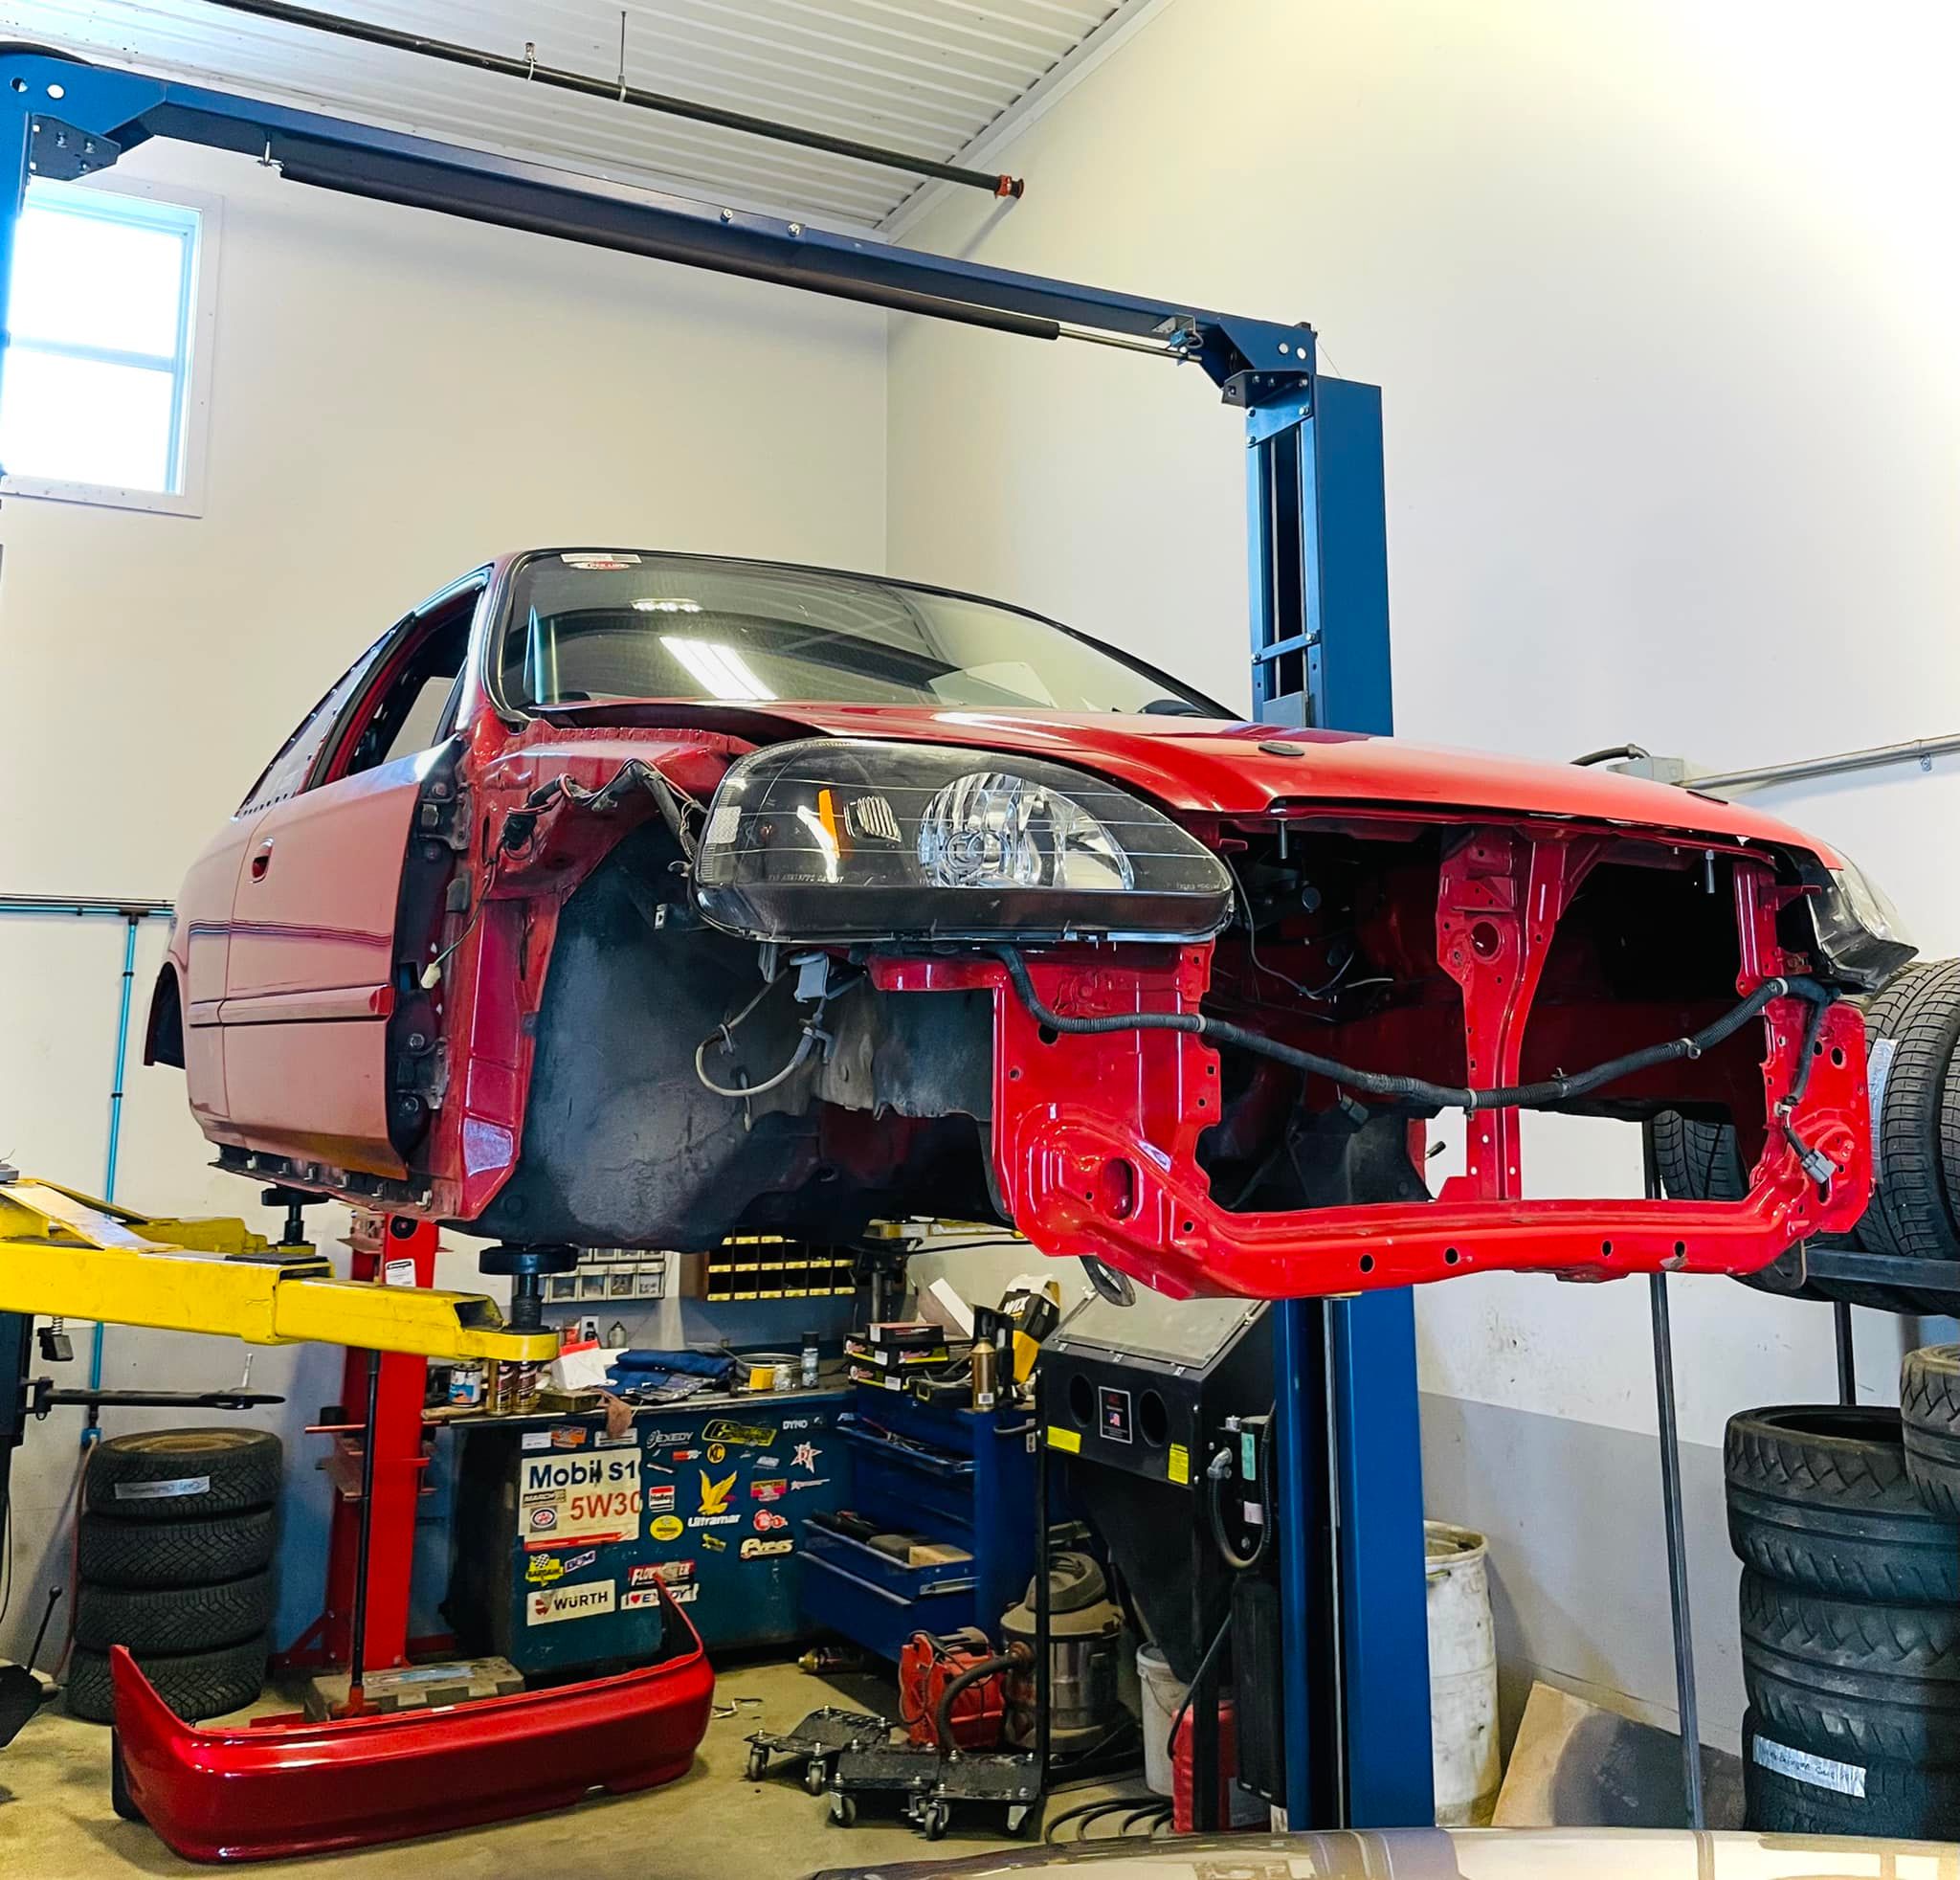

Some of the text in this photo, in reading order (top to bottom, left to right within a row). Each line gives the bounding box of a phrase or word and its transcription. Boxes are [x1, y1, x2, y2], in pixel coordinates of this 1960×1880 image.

[1004, 1295, 1031, 1315] WIX
[783, 1420, 809, 1430] DYNO
[656, 1432, 694, 1444] EXEDY
[709, 1444, 724, 1462] KC
[569, 1490, 641, 1521] 5W30
[688, 1514, 742, 1528] Ultramar
[554, 1591, 609, 1611] WÜRTH
